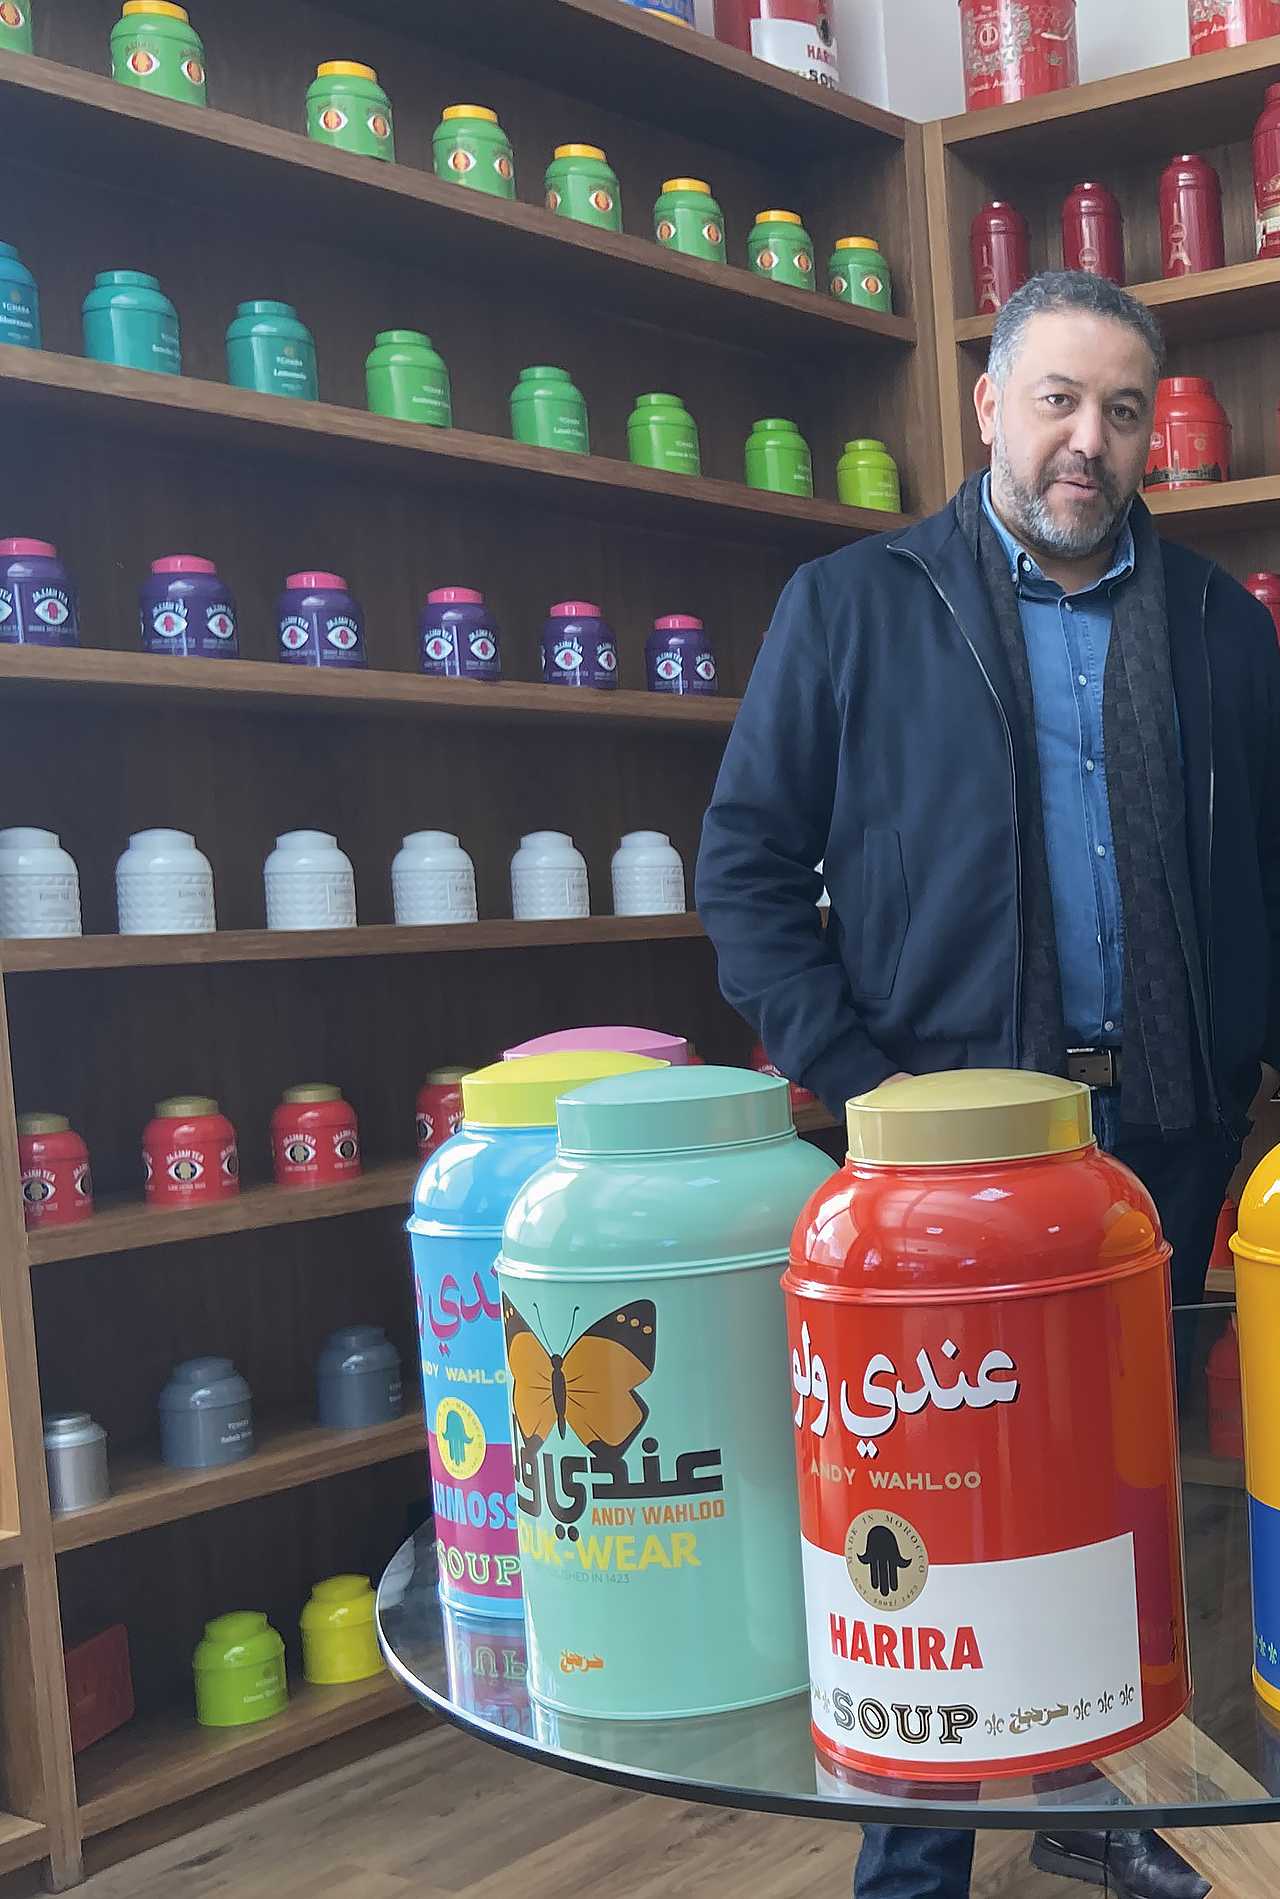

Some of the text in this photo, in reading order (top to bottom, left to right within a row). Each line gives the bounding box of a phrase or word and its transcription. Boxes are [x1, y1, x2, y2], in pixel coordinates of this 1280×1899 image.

[446, 1366, 506, 1384] WAHLO
[792, 1320, 1021, 1459] عندي ولو
[811, 1460, 982, 1491] ANDY WAHLOO
[592, 1499, 725, 1527] ANDY WAHLOO
[518, 1519, 702, 1571] OUK-WEAR
[847, 1514, 926, 1574] MADE IN MOROCCO
[592, 1573, 603, 1583] IN
[605, 1573, 630, 1584] 1423
[829, 1611, 985, 1671] HARIRA
[832, 1687, 978, 1745] SOUP
